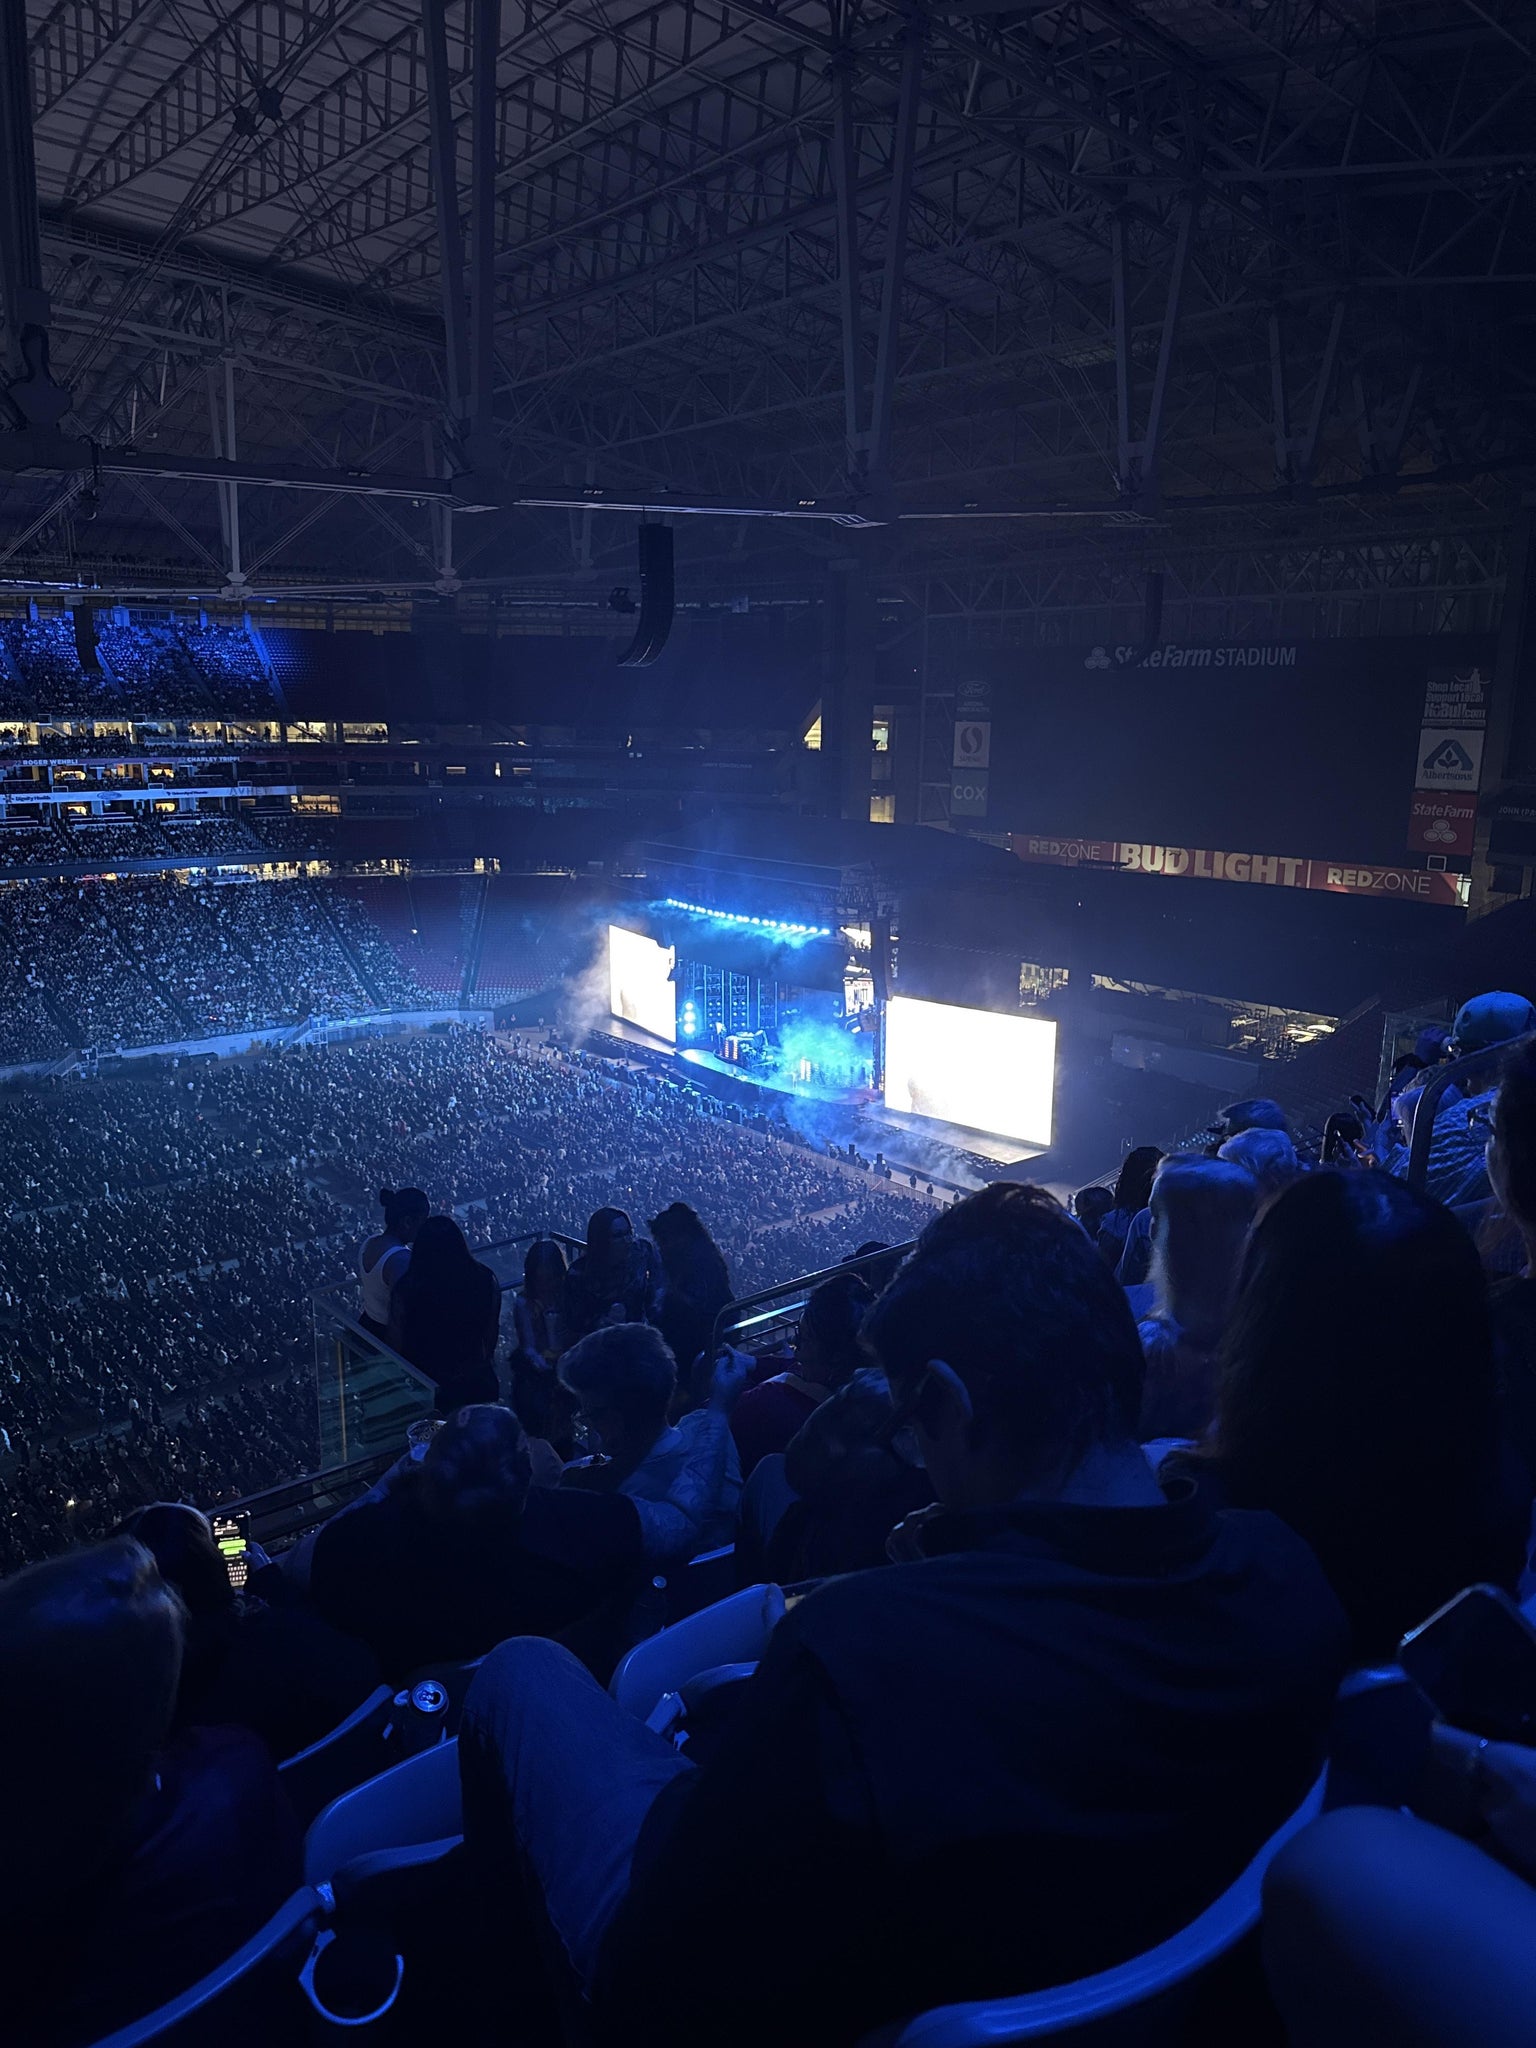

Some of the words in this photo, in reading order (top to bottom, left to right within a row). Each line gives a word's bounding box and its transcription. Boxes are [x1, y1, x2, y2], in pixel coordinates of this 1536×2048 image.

[1214, 646, 1297, 667] STADIUM
[1427, 681, 1449, 692] Shop
[1449, 681, 1473, 692] Local
[1425, 692, 1460, 703] Support
[1460, 692, 1484, 703] Local
[1422, 769, 1473, 781] Albertsons
[953, 785, 986, 801] COX
[1498, 806, 1520, 815] JOHN
[1028, 840, 1101, 860] REDZONE
[1119, 842, 1190, 874] BUD
[1194, 849, 1304, 887] LIGHT
[1327, 867, 1432, 895] REDZONE
